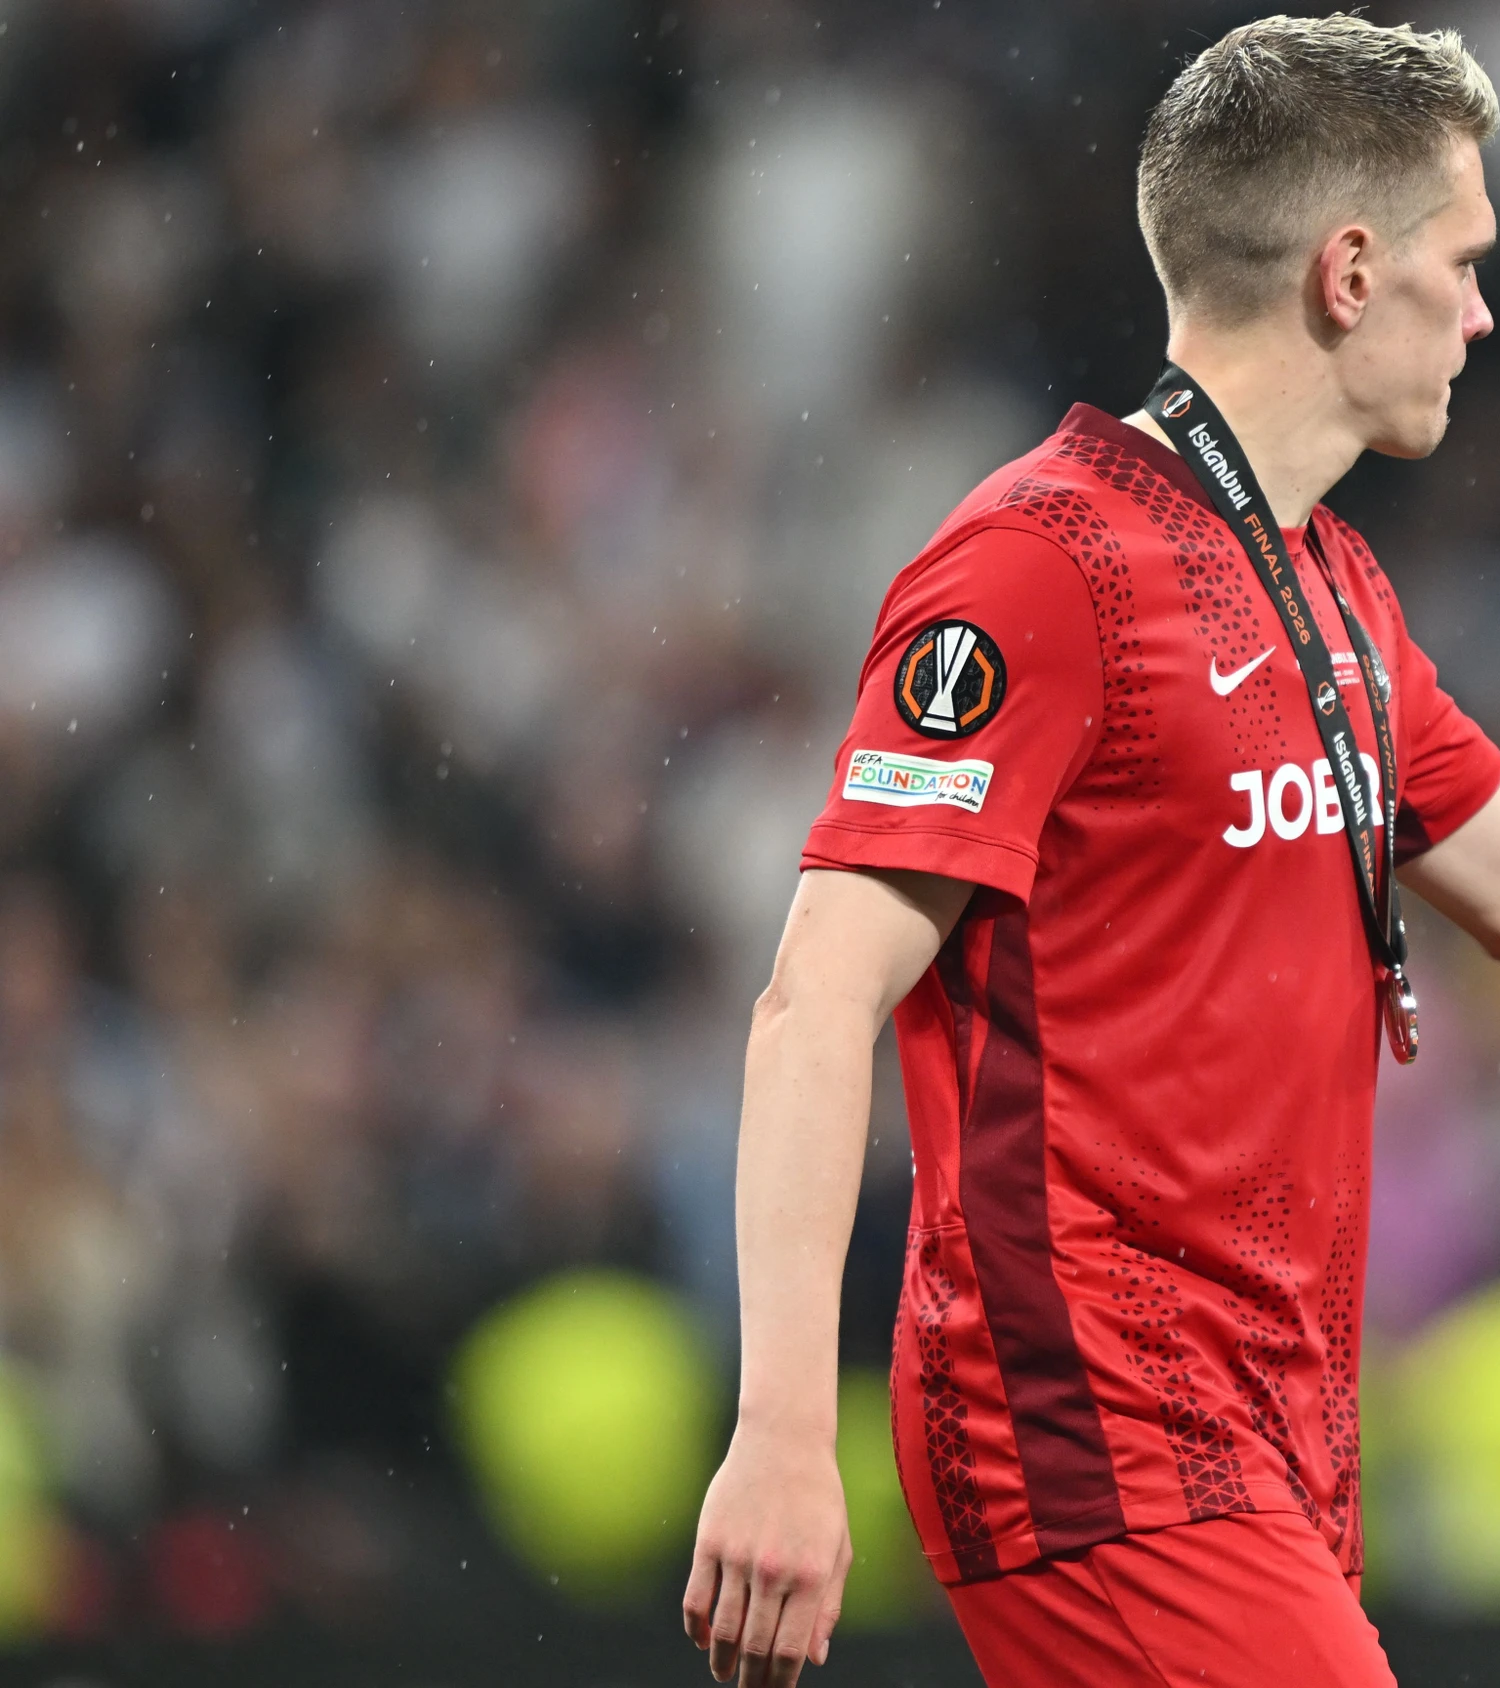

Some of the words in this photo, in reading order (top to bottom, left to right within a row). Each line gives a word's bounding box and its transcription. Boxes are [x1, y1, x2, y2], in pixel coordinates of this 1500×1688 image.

[1244, 513, 1285, 585] FINAL
[1280, 586, 1311, 645] 2026
[853, 753, 883, 765] UEFA
[935, 790, 947, 801] for
[949, 793, 979, 808] children
